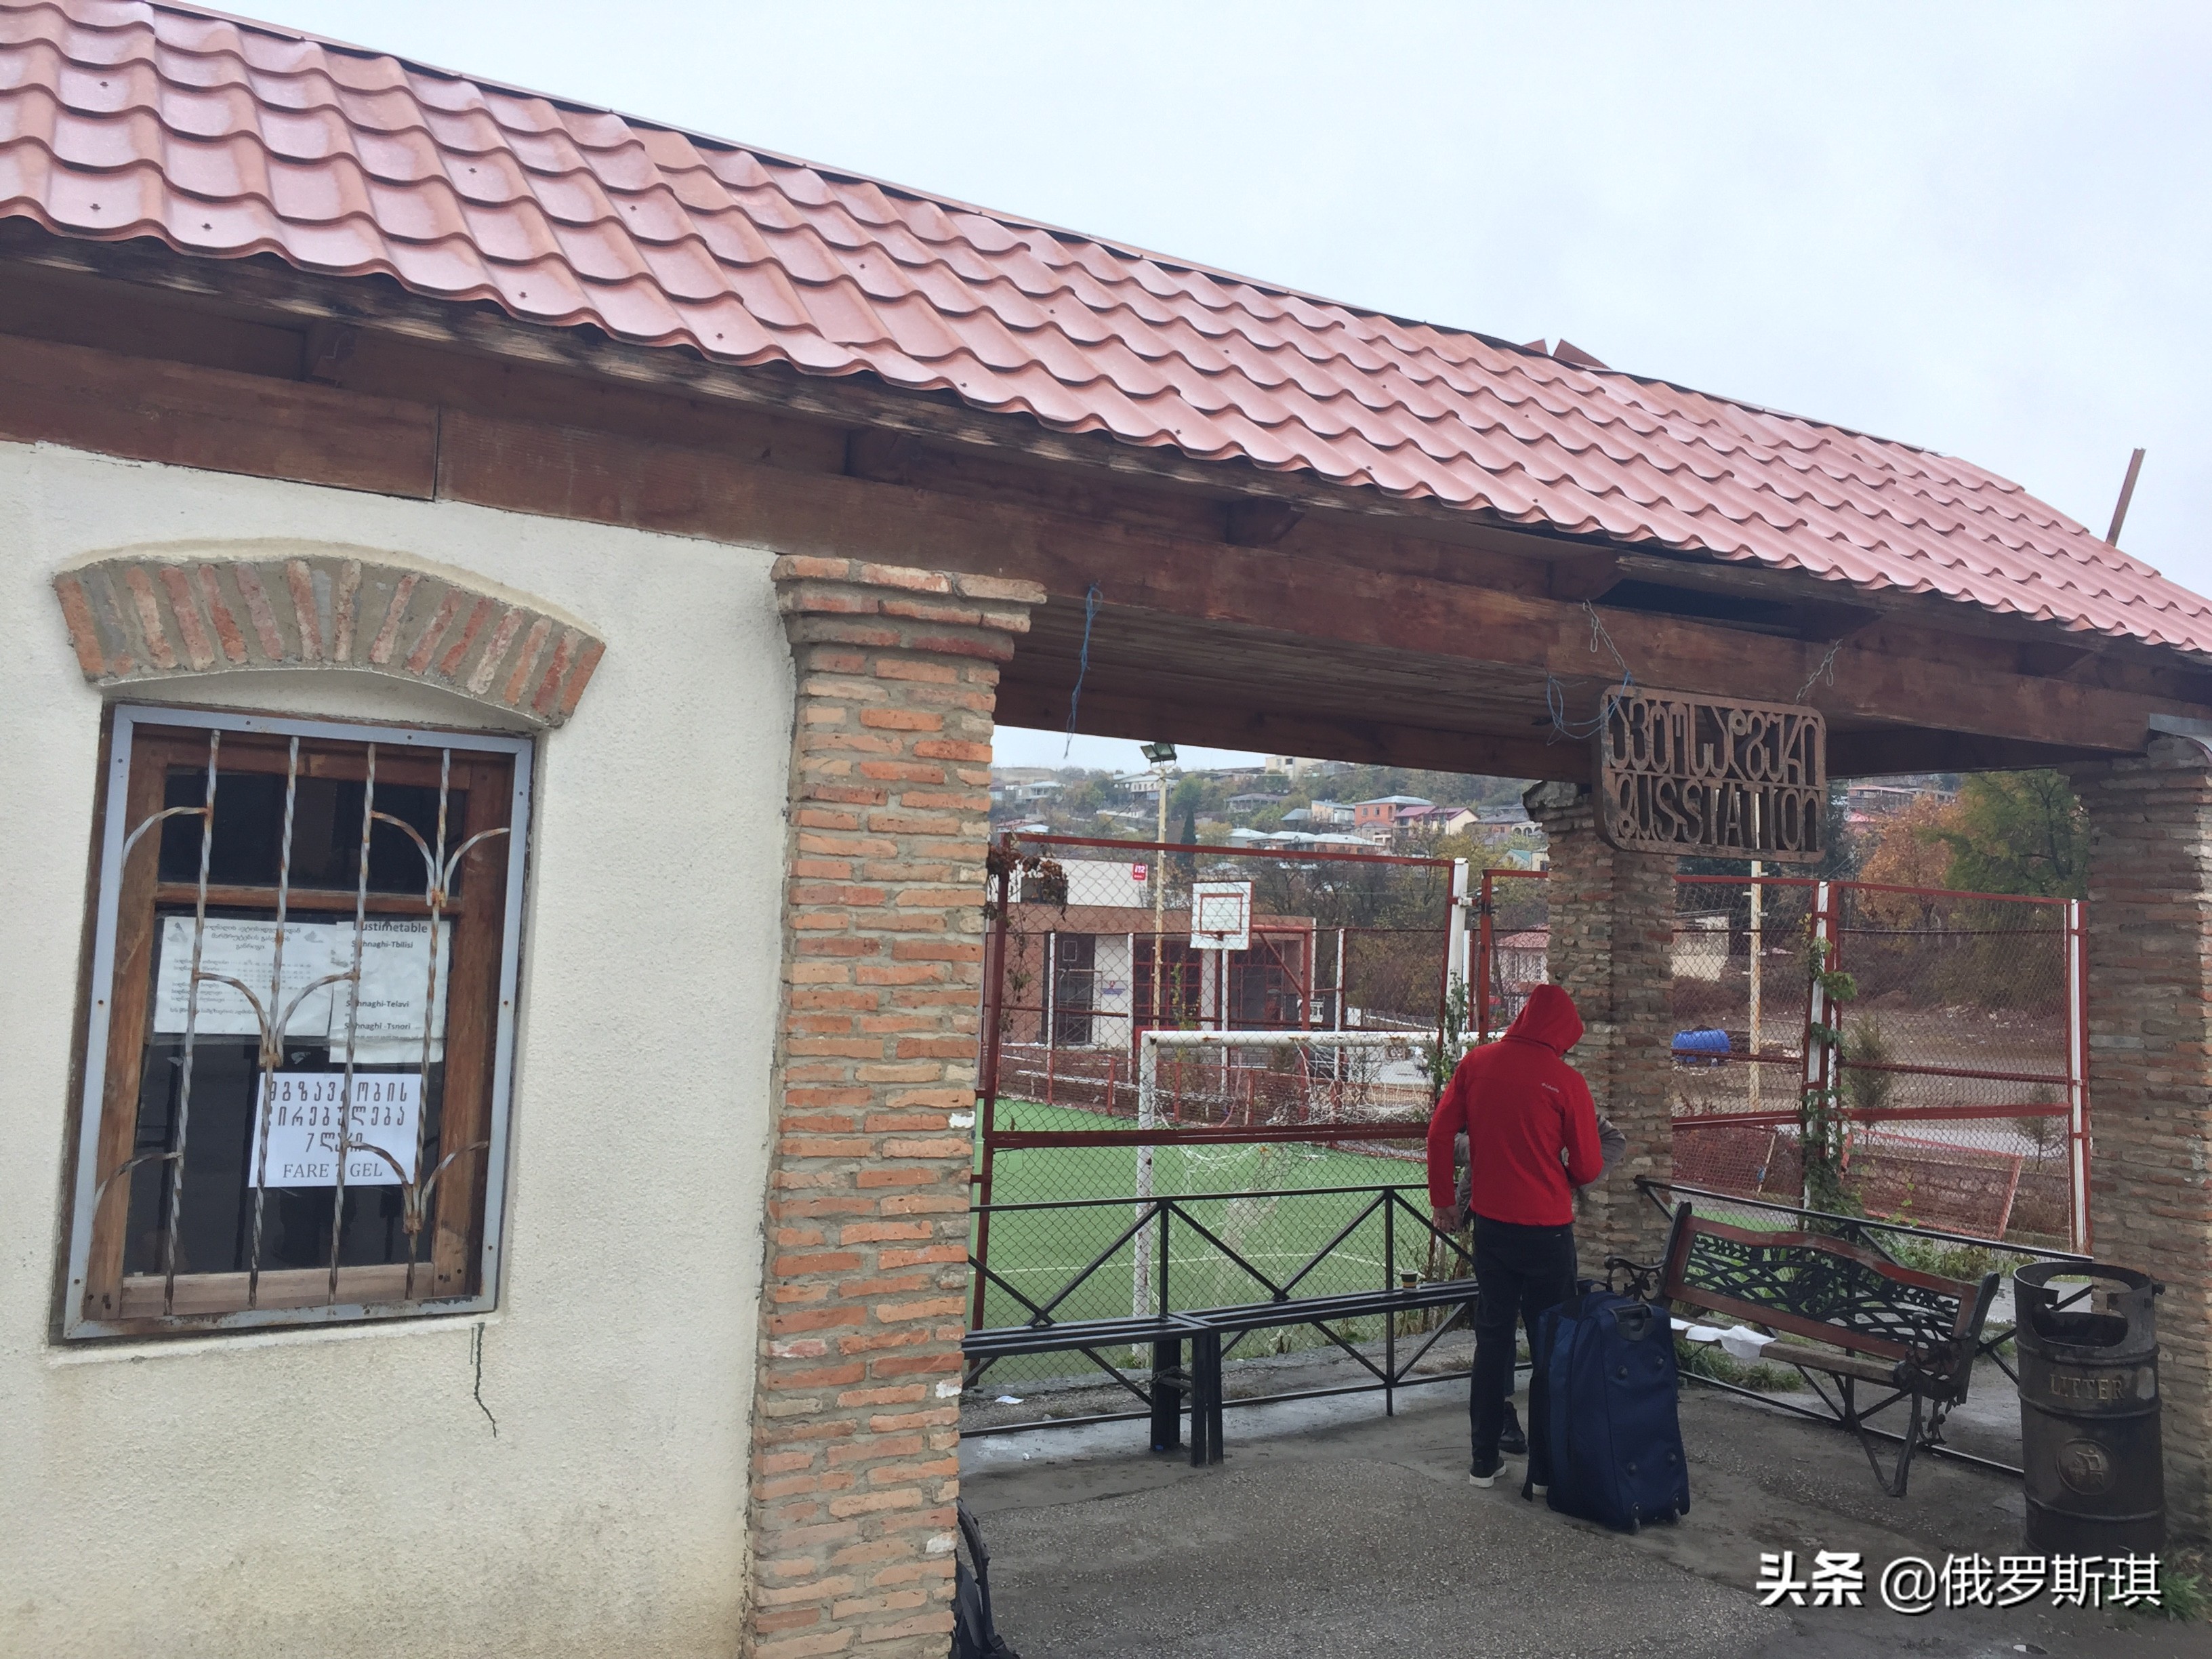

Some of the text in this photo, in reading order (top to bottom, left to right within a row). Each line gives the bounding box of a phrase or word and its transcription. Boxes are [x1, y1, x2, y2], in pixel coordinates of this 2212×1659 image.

[351, 940, 413, 949] Shnaghi-Tbilisi
[346, 1000, 409, 1008] Shnaghi-Telavi
[344, 1022, 382, 1031] Shnaghi
[267, 1105, 405, 1126] ირებლება
[306, 1132, 314, 1153] 7
[283, 1164, 329, 1179] FARE
[350, 1163, 383, 1177] GEL
[2050, 1374, 2126, 1400] LITTER
